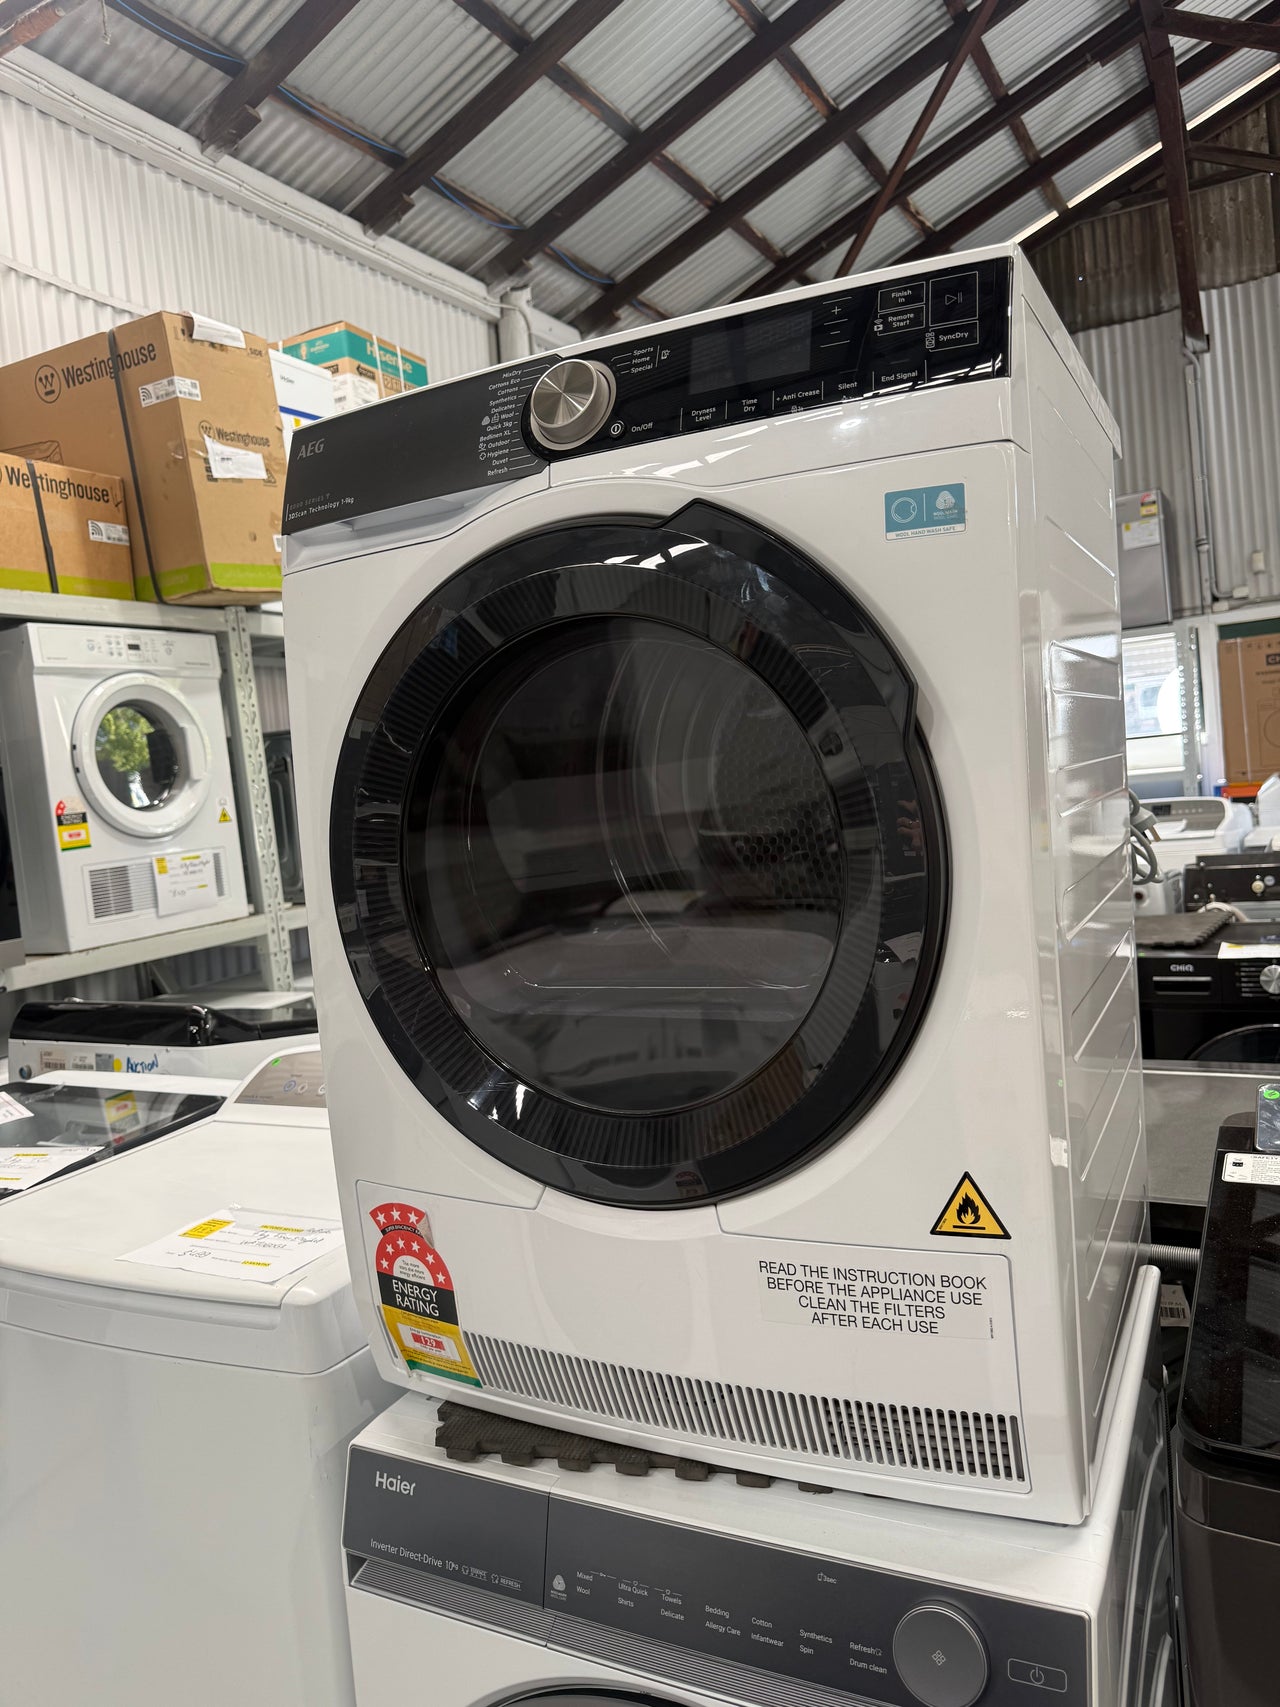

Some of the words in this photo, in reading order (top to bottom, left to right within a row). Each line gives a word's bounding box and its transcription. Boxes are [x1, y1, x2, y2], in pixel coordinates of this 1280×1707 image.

[891, 290, 912, 299] Finish
[888, 312, 914, 322] Remote
[892, 320, 910, 328] Start
[939, 332, 969, 341] SyncDry
[633, 347, 653, 356] Sports
[632, 356, 650, 364] Home
[631, 363, 653, 374] Special
[502, 370, 522, 378] MixDry
[881, 374, 895, 382] End
[896, 370, 918, 380] Signal
[488, 381, 509, 390] Cottons
[838, 381, 858, 390] Silent
[497, 386, 518, 396] Cottons
[798, 389, 820, 398] Crease
[489, 395, 517, 406] Synthetics
[742, 398, 758, 406] Time
[491, 403, 515, 414] Delicates
[691, 407, 716, 416] Dryness
[695, 414, 712, 422] Level
[486, 423, 501, 431] Quick
[631, 422, 653, 432] On/Off
[480, 432, 502, 442] Bedlinen
[488, 439, 510, 448] Outdoor
[297, 438, 325, 460] AEG
[487, 449, 509, 458] Hygiene
[492, 458, 509, 466] Duvet
[488, 467, 508, 476] Refresh
[5, 465, 110, 503] Wetinghouse
[288, 511, 307, 520] 3DScan
[309, 501, 340, 514] Technology
[759, 1261, 796, 1276] READ
[800, 1265, 828, 1279] THE
[833, 1267, 935, 1287] INSTRUCTION
[941, 1275, 987, 1290] BOOK
[393, 1279, 437, 1302] ENERGY
[767, 1277, 824, 1294] BEFORE
[827, 1283, 856, 1298] THE
[861, 1286, 946, 1304] APPLIANCE
[950, 1292, 983, 1306] USE
[396, 1294, 440, 1317] RATING
[799, 1296, 846, 1311] CLEAN
[850, 1300, 879, 1314] THE
[885, 1303, 945, 1319] FILTERS
[812, 1312, 858, 1328] AFTER
[862, 1316, 903, 1332] EACH
[908, 1321, 939, 1335] USE
[421, 1336, 436, 1346] 129
[375, 1471, 416, 1496] Haier
[370, 1538, 398, 1555] Inverter
[400, 1547, 442, 1568] Direct-Drive
[577, 1571, 593, 1581] Mixed
[577, 1586, 590, 1595] Wool
[618, 1582, 631, 1593] Ultra
[632, 1586, 648, 1596] Quick
[618, 1598, 634, 1608] Shirts
[662, 1594, 682, 1605] Towels
[661, 1609, 684, 1621] Delicate
[705, 1605, 730, 1619] Bedding
[751, 1617, 772, 1628] Cotton
[705, 1621, 725, 1633] Allergy
[727, 1627, 741, 1636] Care
[751, 1633, 784, 1647] Infantwear
[800, 1629, 833, 1644] Synthetics
[800, 1645, 814, 1655] Spin
[850, 1642, 876, 1655] Refresh
[850, 1658, 868, 1669] Drum
[869, 1664, 887, 1674] clean
